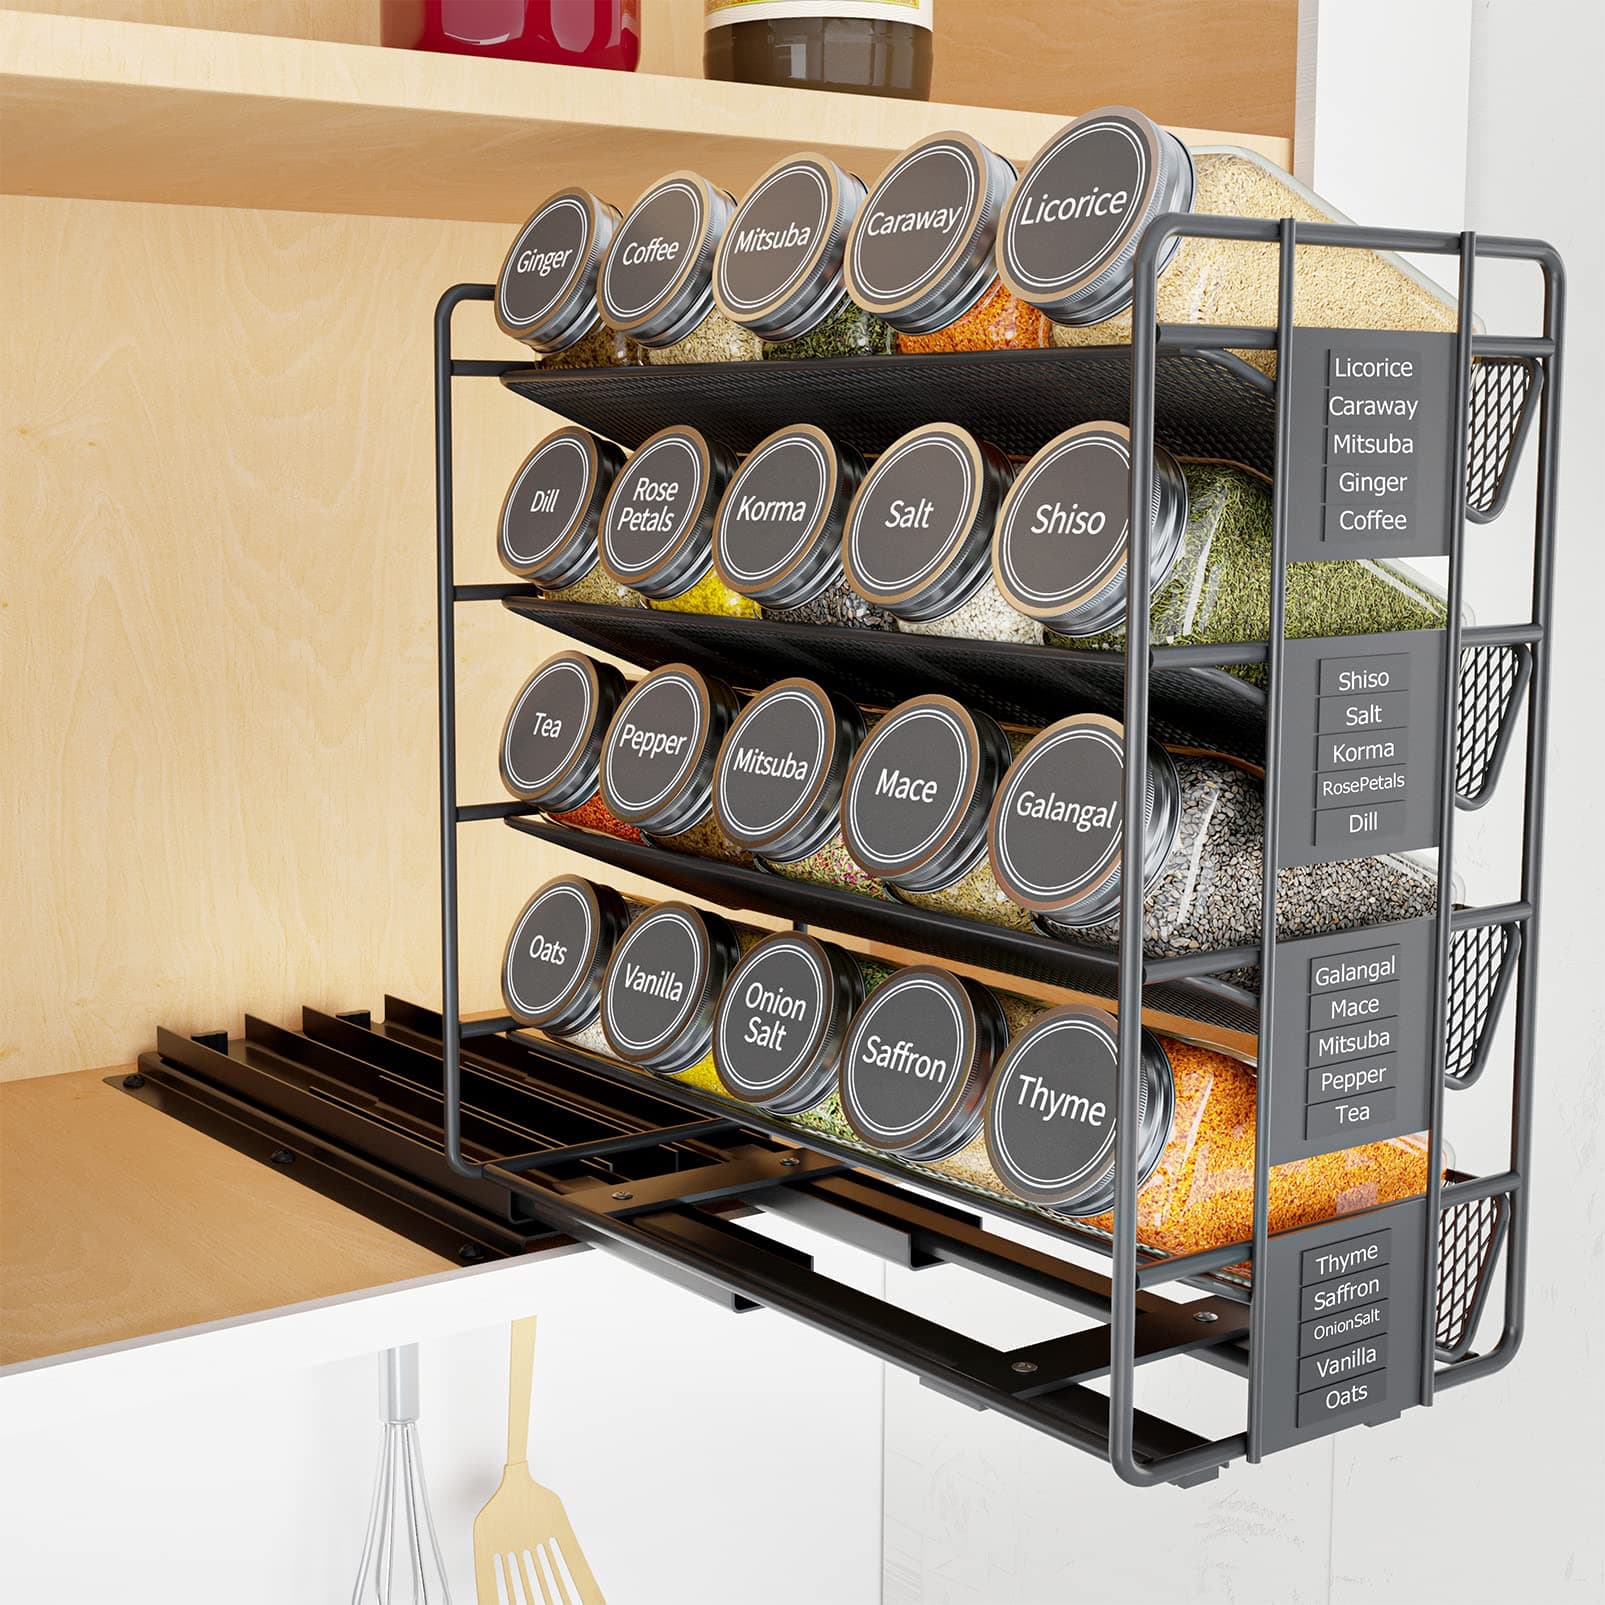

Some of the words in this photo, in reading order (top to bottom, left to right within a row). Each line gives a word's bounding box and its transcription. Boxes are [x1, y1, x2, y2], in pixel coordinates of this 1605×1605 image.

[1019, 186, 1128, 226] Licorice
[867, 205, 964, 237] Caraway
[622, 236, 680, 266] Coffee
[733, 221, 811, 255] Mitsuba
[516, 248, 574, 277] Ginger
[1335, 357, 1413, 378] Licorice
[1328, 395, 1419, 421] Caraway
[1333, 432, 1414, 454] Mitsuba
[632, 477, 679, 502] Rose
[1338, 471, 1408, 497] Ginger
[530, 488, 560, 513] Dill
[735, 495, 807, 522] Korma
[884, 497, 935, 529] Salt
[616, 505, 675, 532] Petals
[1030, 502, 1106, 535] Shiso
[1339, 508, 1408, 531] Coffee
[1338, 669, 1390, 692] Shiso
[532, 711, 562, 739] Tea
[1345, 703, 1383, 727] Salt
[618, 723, 688, 759] Pepper
[1333, 742, 1395, 764] Korma
[732, 747, 809, 781] Mitsuba
[874, 767, 938, 803] Mace
[1322, 771, 1406, 797] RosePetals
[1016, 790, 1118, 833] Galangal
[1349, 810, 1378, 834] Dill
[529, 934, 568, 966] Oats
[624, 962, 683, 1002] Vanilla
[1315, 954, 1396, 987] Galangal
[745, 982, 807, 1022] Onion
[1331, 998, 1380, 1020] Mace
[743, 1016, 787, 1052] Salt
[1318, 1029, 1391, 1057] Mitsuba
[861, 1035, 947, 1083] Saffron
[1321, 1067, 1387, 1093] Pepper
[1017, 1074, 1106, 1127] Thyme
[1334, 1104, 1370, 1124] Tea
[1315, 1244, 1379, 1276] Thyme
[1313, 1278, 1380, 1311] Saffron
[1313, 1308, 1381, 1340] OnionSalt
[1316, 1346, 1377, 1378] Vanilla
[1325, 1384, 1368, 1409] Oats
